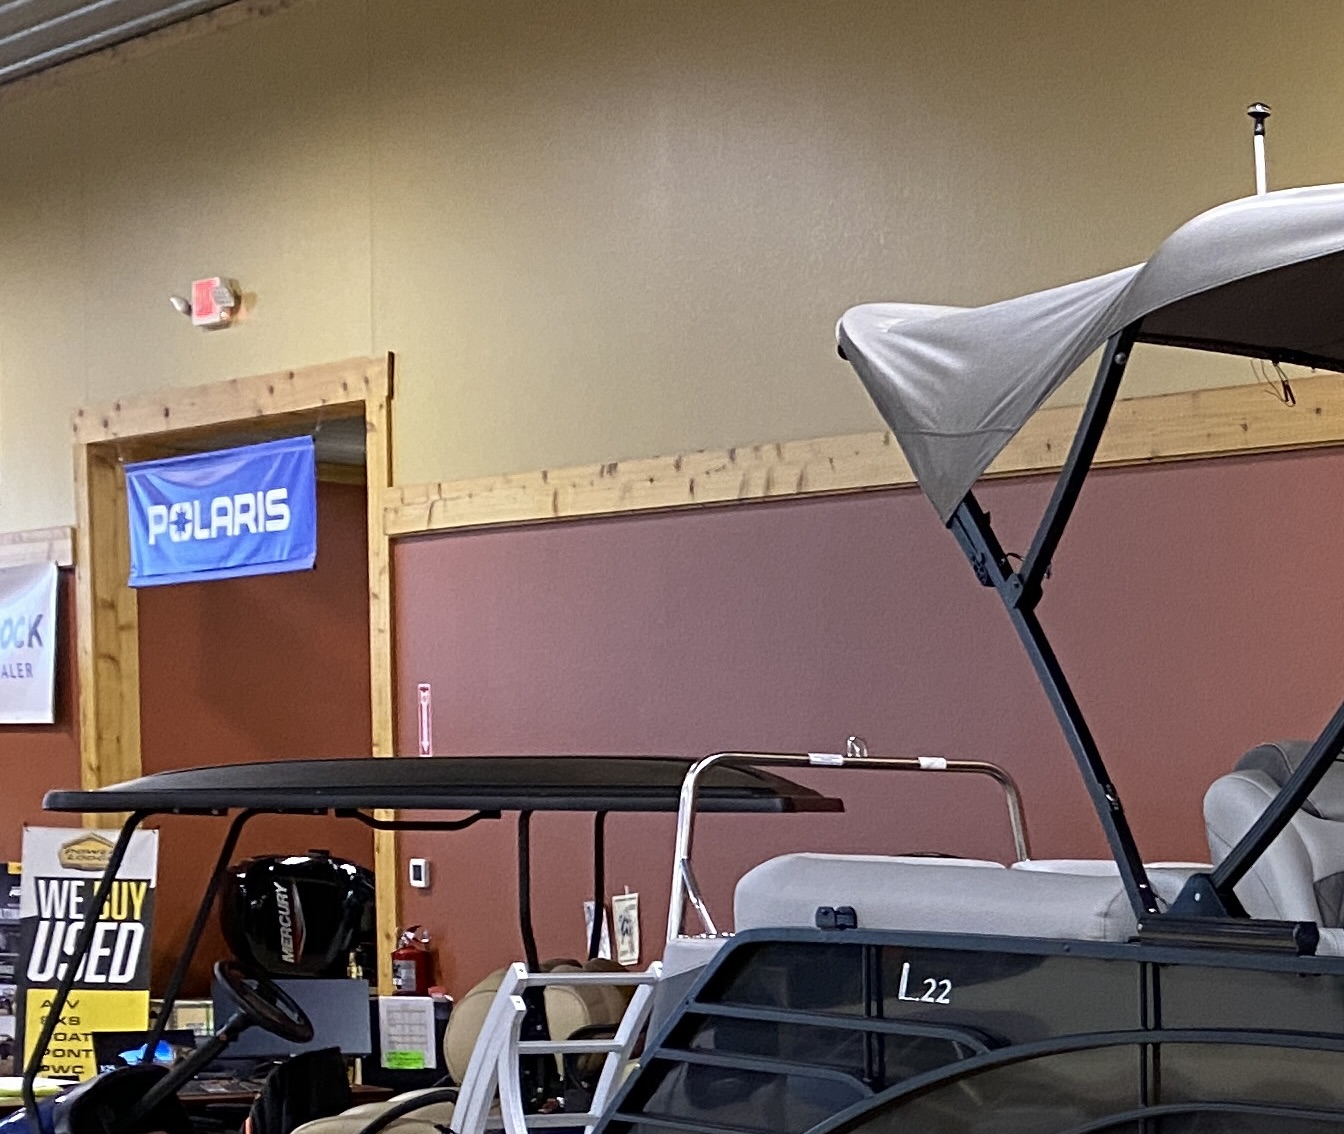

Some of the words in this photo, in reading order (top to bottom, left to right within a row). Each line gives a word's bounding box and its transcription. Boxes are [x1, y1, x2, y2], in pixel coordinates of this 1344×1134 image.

[147, 487, 291, 545] POLARIS
[37, 879, 85, 919] WE
[273, 881, 295, 963] MERCURY
[40, 999, 80, 1009] AV
[47, 1032, 92, 1042] OAT
